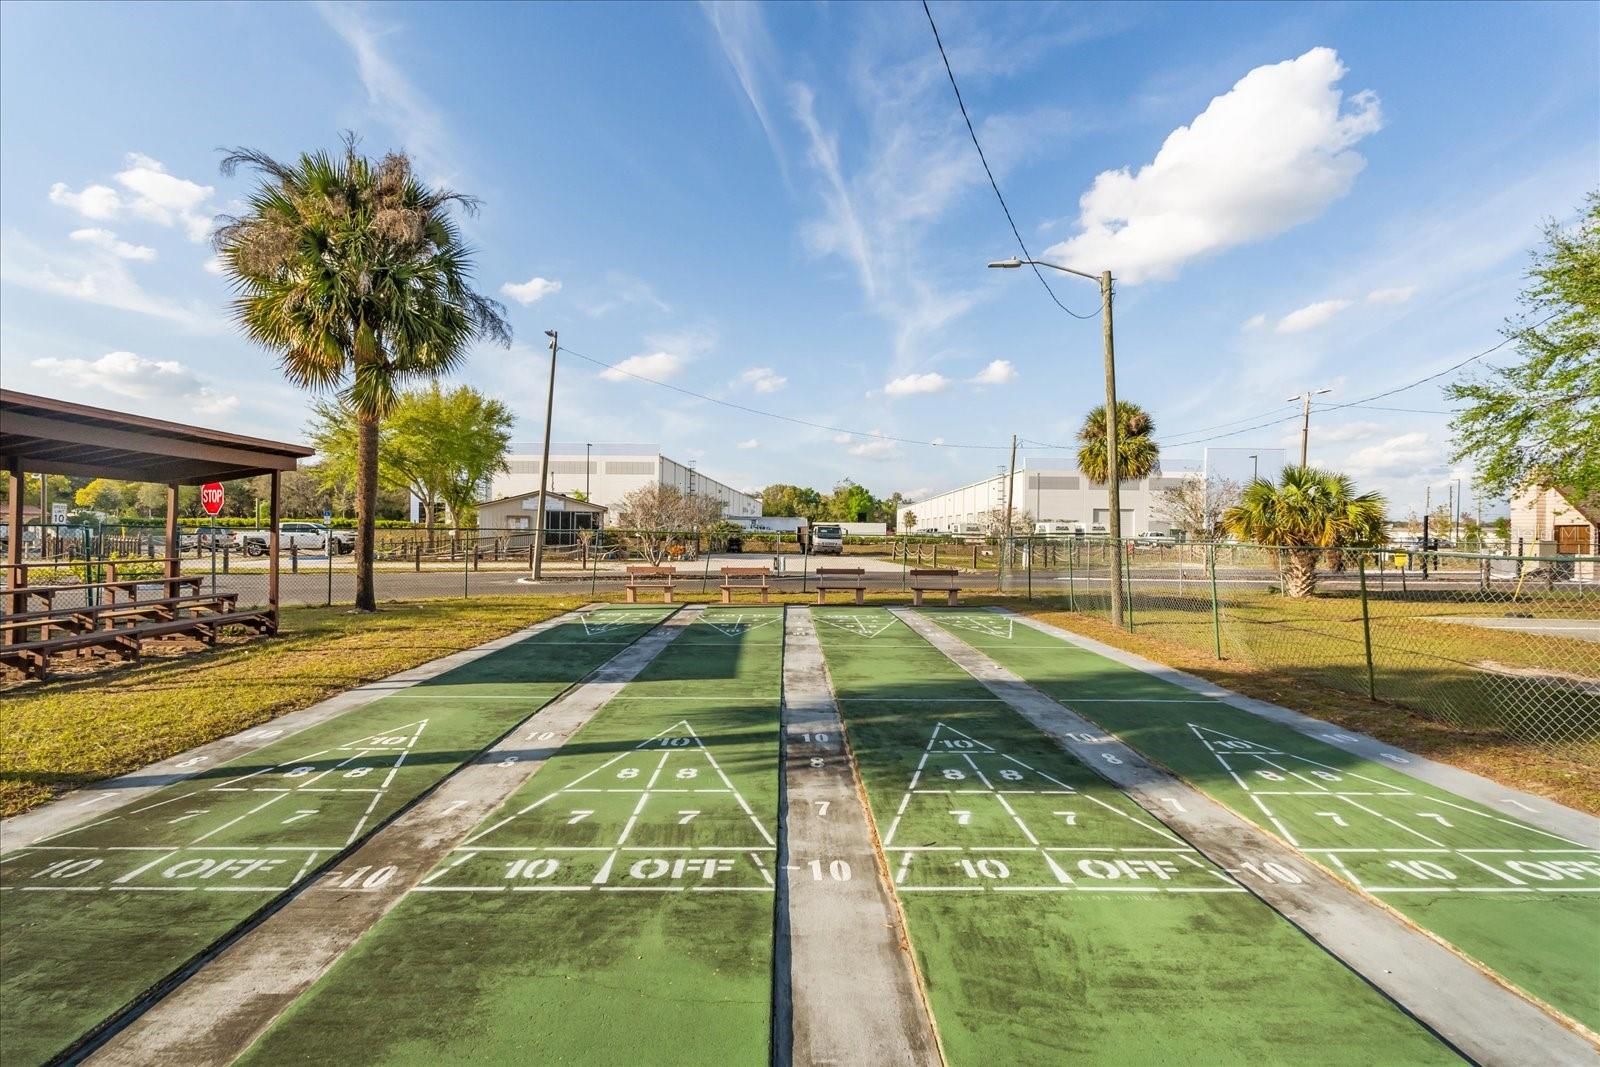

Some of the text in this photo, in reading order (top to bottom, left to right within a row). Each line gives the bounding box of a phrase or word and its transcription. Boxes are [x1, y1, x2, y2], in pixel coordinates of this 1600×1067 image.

[203, 489, 222, 503] STOP
[54, 514, 65, 523] 10
[369, 736, 407, 745] 10
[525, 732, 554, 740] 10
[658, 737, 690, 746] 10
[801, 733, 828, 743] 10
[1065, 733, 1098, 743] 10
[939, 740, 974, 749] 10
[1213, 740, 1252, 749] 10
[175, 756, 209, 768] 8
[497, 756, 519, 767] 8
[810, 757, 825, 768] 8
[1101, 753, 1123, 765] 8
[1379, 753, 1410, 764] 8
[283, 766, 315, 778] 8
[343, 767, 374, 778] 8
[616, 768, 640, 779] 8
[676, 768, 698, 779] 8
[942, 769, 966, 780] 8
[1000, 769, 1024, 780] 8
[1254, 770, 1286, 781] 8
[1310, 770, 1343, 782] 8
[439, 800, 469, 815] 7
[814, 801, 831, 816] 7
[1161, 798, 1187, 813] 7
[1501, 799, 1542, 814] 7
[168, 810, 211, 824] 7
[281, 810, 320, 824] 7
[567, 810, 595, 824] 7
[678, 810, 701, 824] 7
[949, 810, 971, 825] 7
[1053, 811, 1076, 825] 7
[1314, 812, 1350, 827] 7
[1416, 812, 1455, 827] 7
[30, 858, 287, 879] 10 OFF
[504, 858, 736, 879] 10 OFF
[954, 859, 1179, 880] 10 OFF
[1387, 860, 1600, 880] 10 OFF
